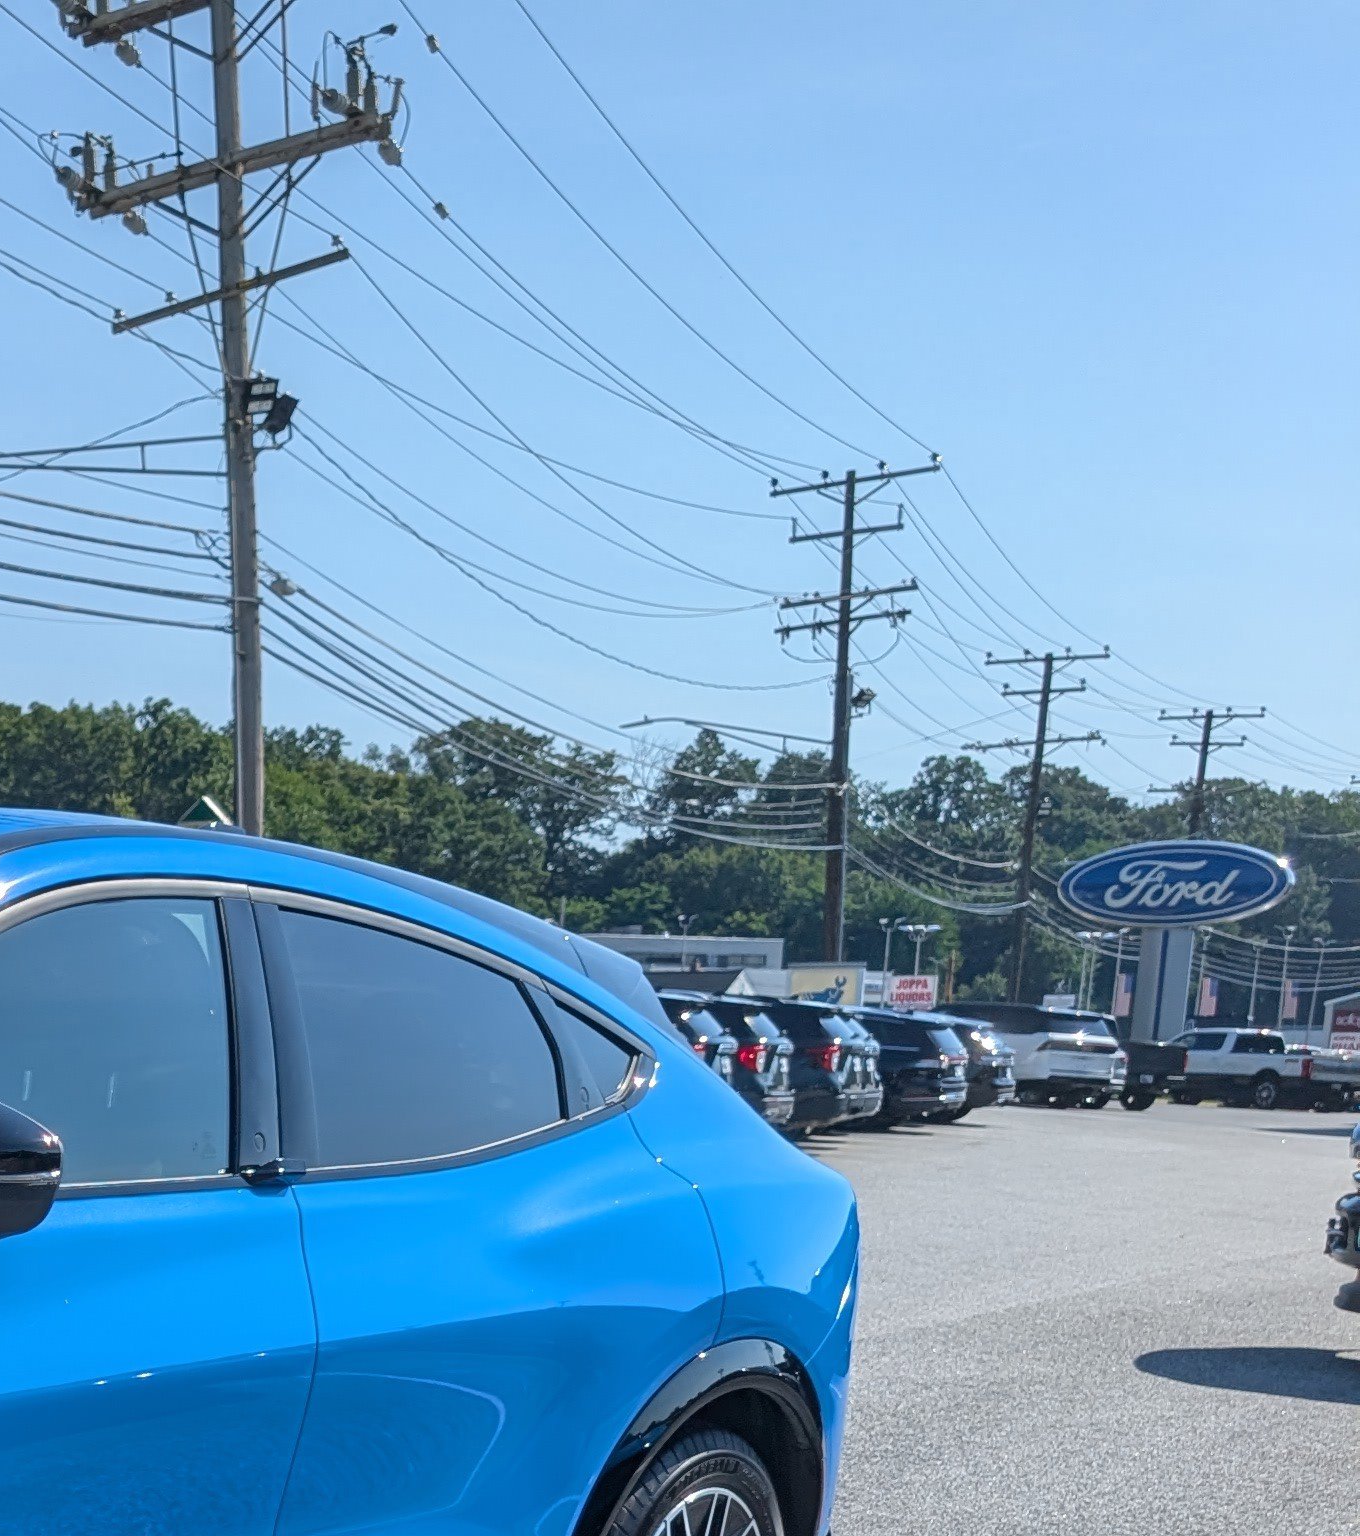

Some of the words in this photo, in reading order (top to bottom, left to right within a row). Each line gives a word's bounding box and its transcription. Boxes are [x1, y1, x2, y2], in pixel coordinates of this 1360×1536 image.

[1104, 859, 1241, 909] Ford
[896, 978, 928, 989] JOPPA
[890, 991, 932, 1003] LIQUORS
